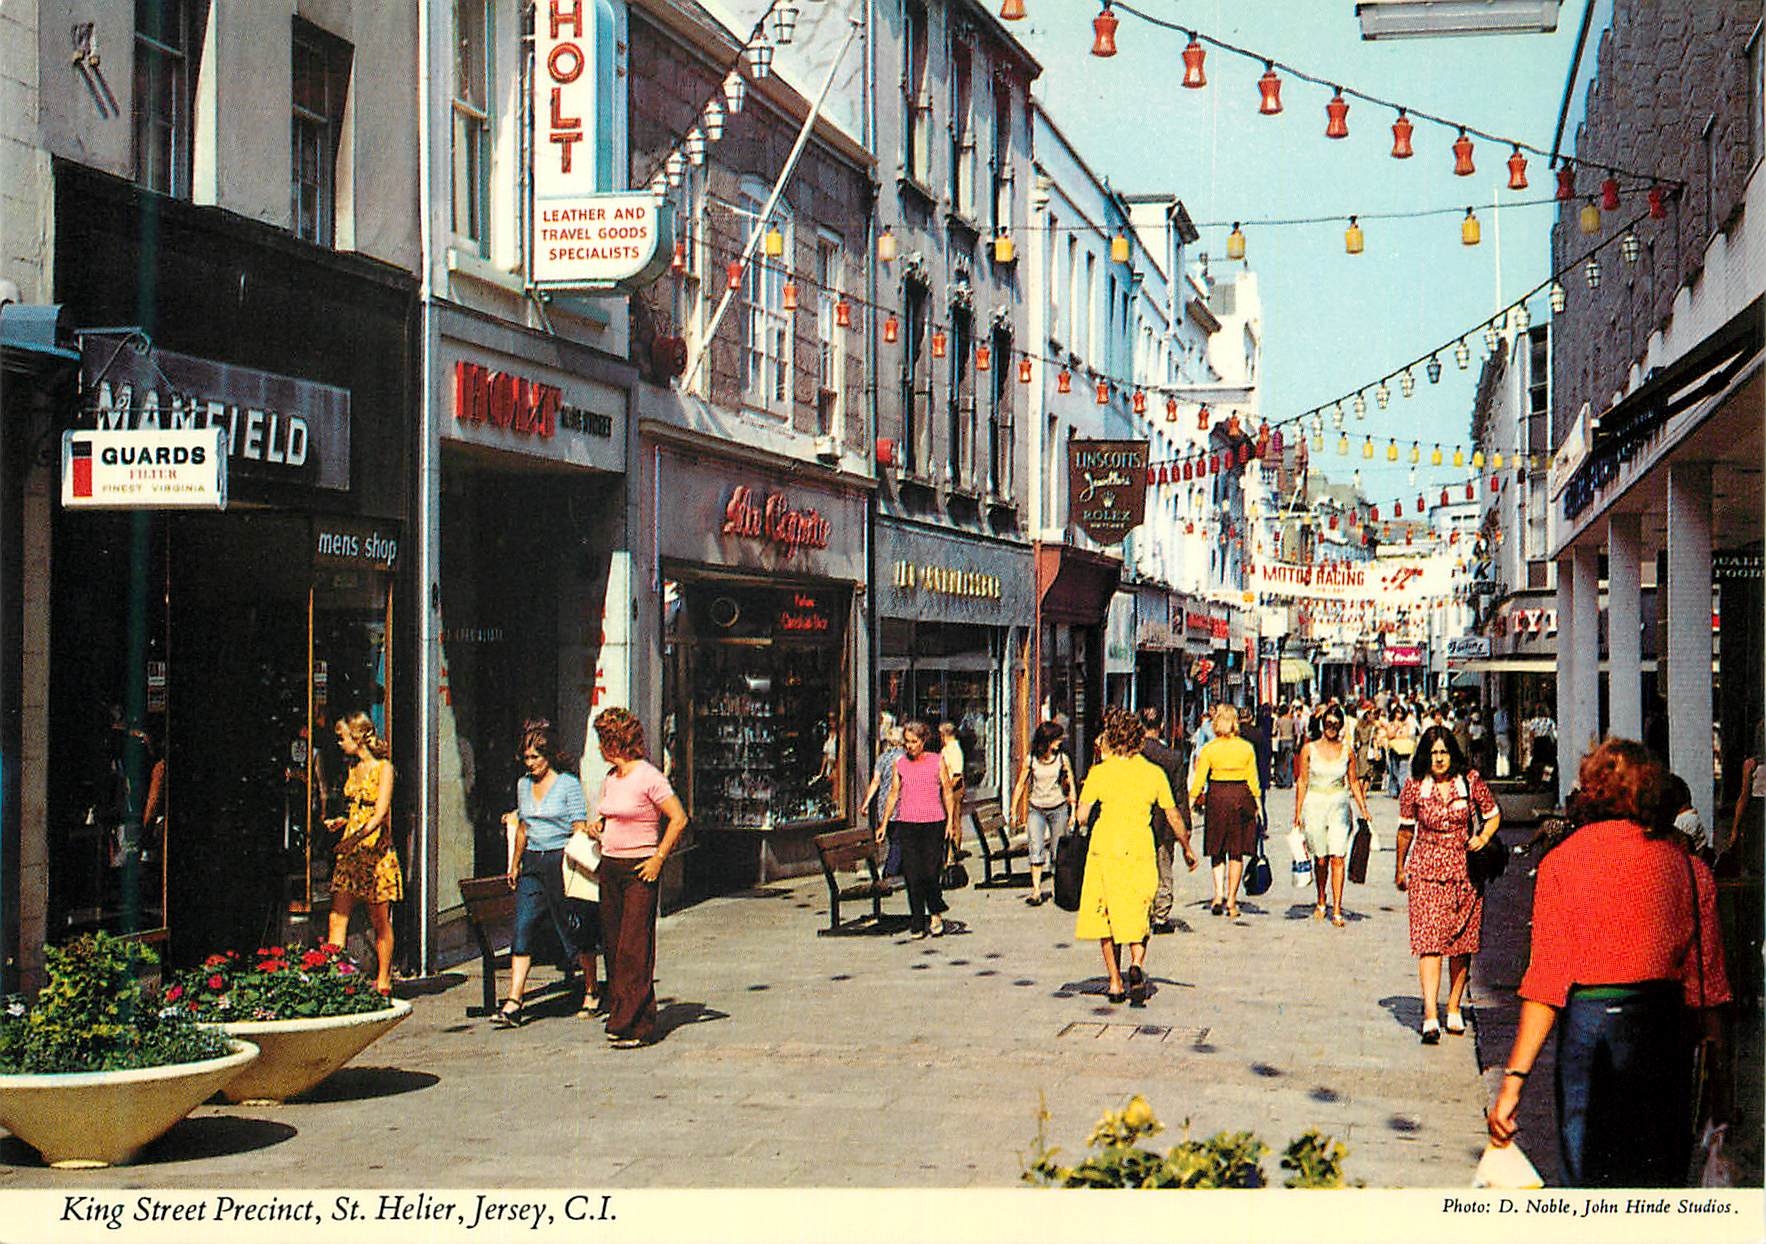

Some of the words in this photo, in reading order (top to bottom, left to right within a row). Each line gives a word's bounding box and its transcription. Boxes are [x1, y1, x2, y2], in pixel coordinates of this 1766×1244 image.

[547, 0, 585, 173] HOLT
[543, 208, 606, 222] LEATHER
[614, 207, 646, 220] AND
[541, 228, 592, 241] TRAVEL
[598, 226, 648, 239] GOODS
[549, 246, 640, 261] SPECIALISTS
[455, 359, 562, 440] HOLT
[101, 446, 206, 466] GUARDS
[129, 469, 178, 480] FILTER
[102, 483, 143, 494] FINEST
[152, 483, 206, 494] VIRGINIA
[1083, 510, 1131, 521] ROLEX
[318, 532, 360, 556] mens
[364, 531, 398, 566] shop
[1316, 568, 1365, 586] RACING
